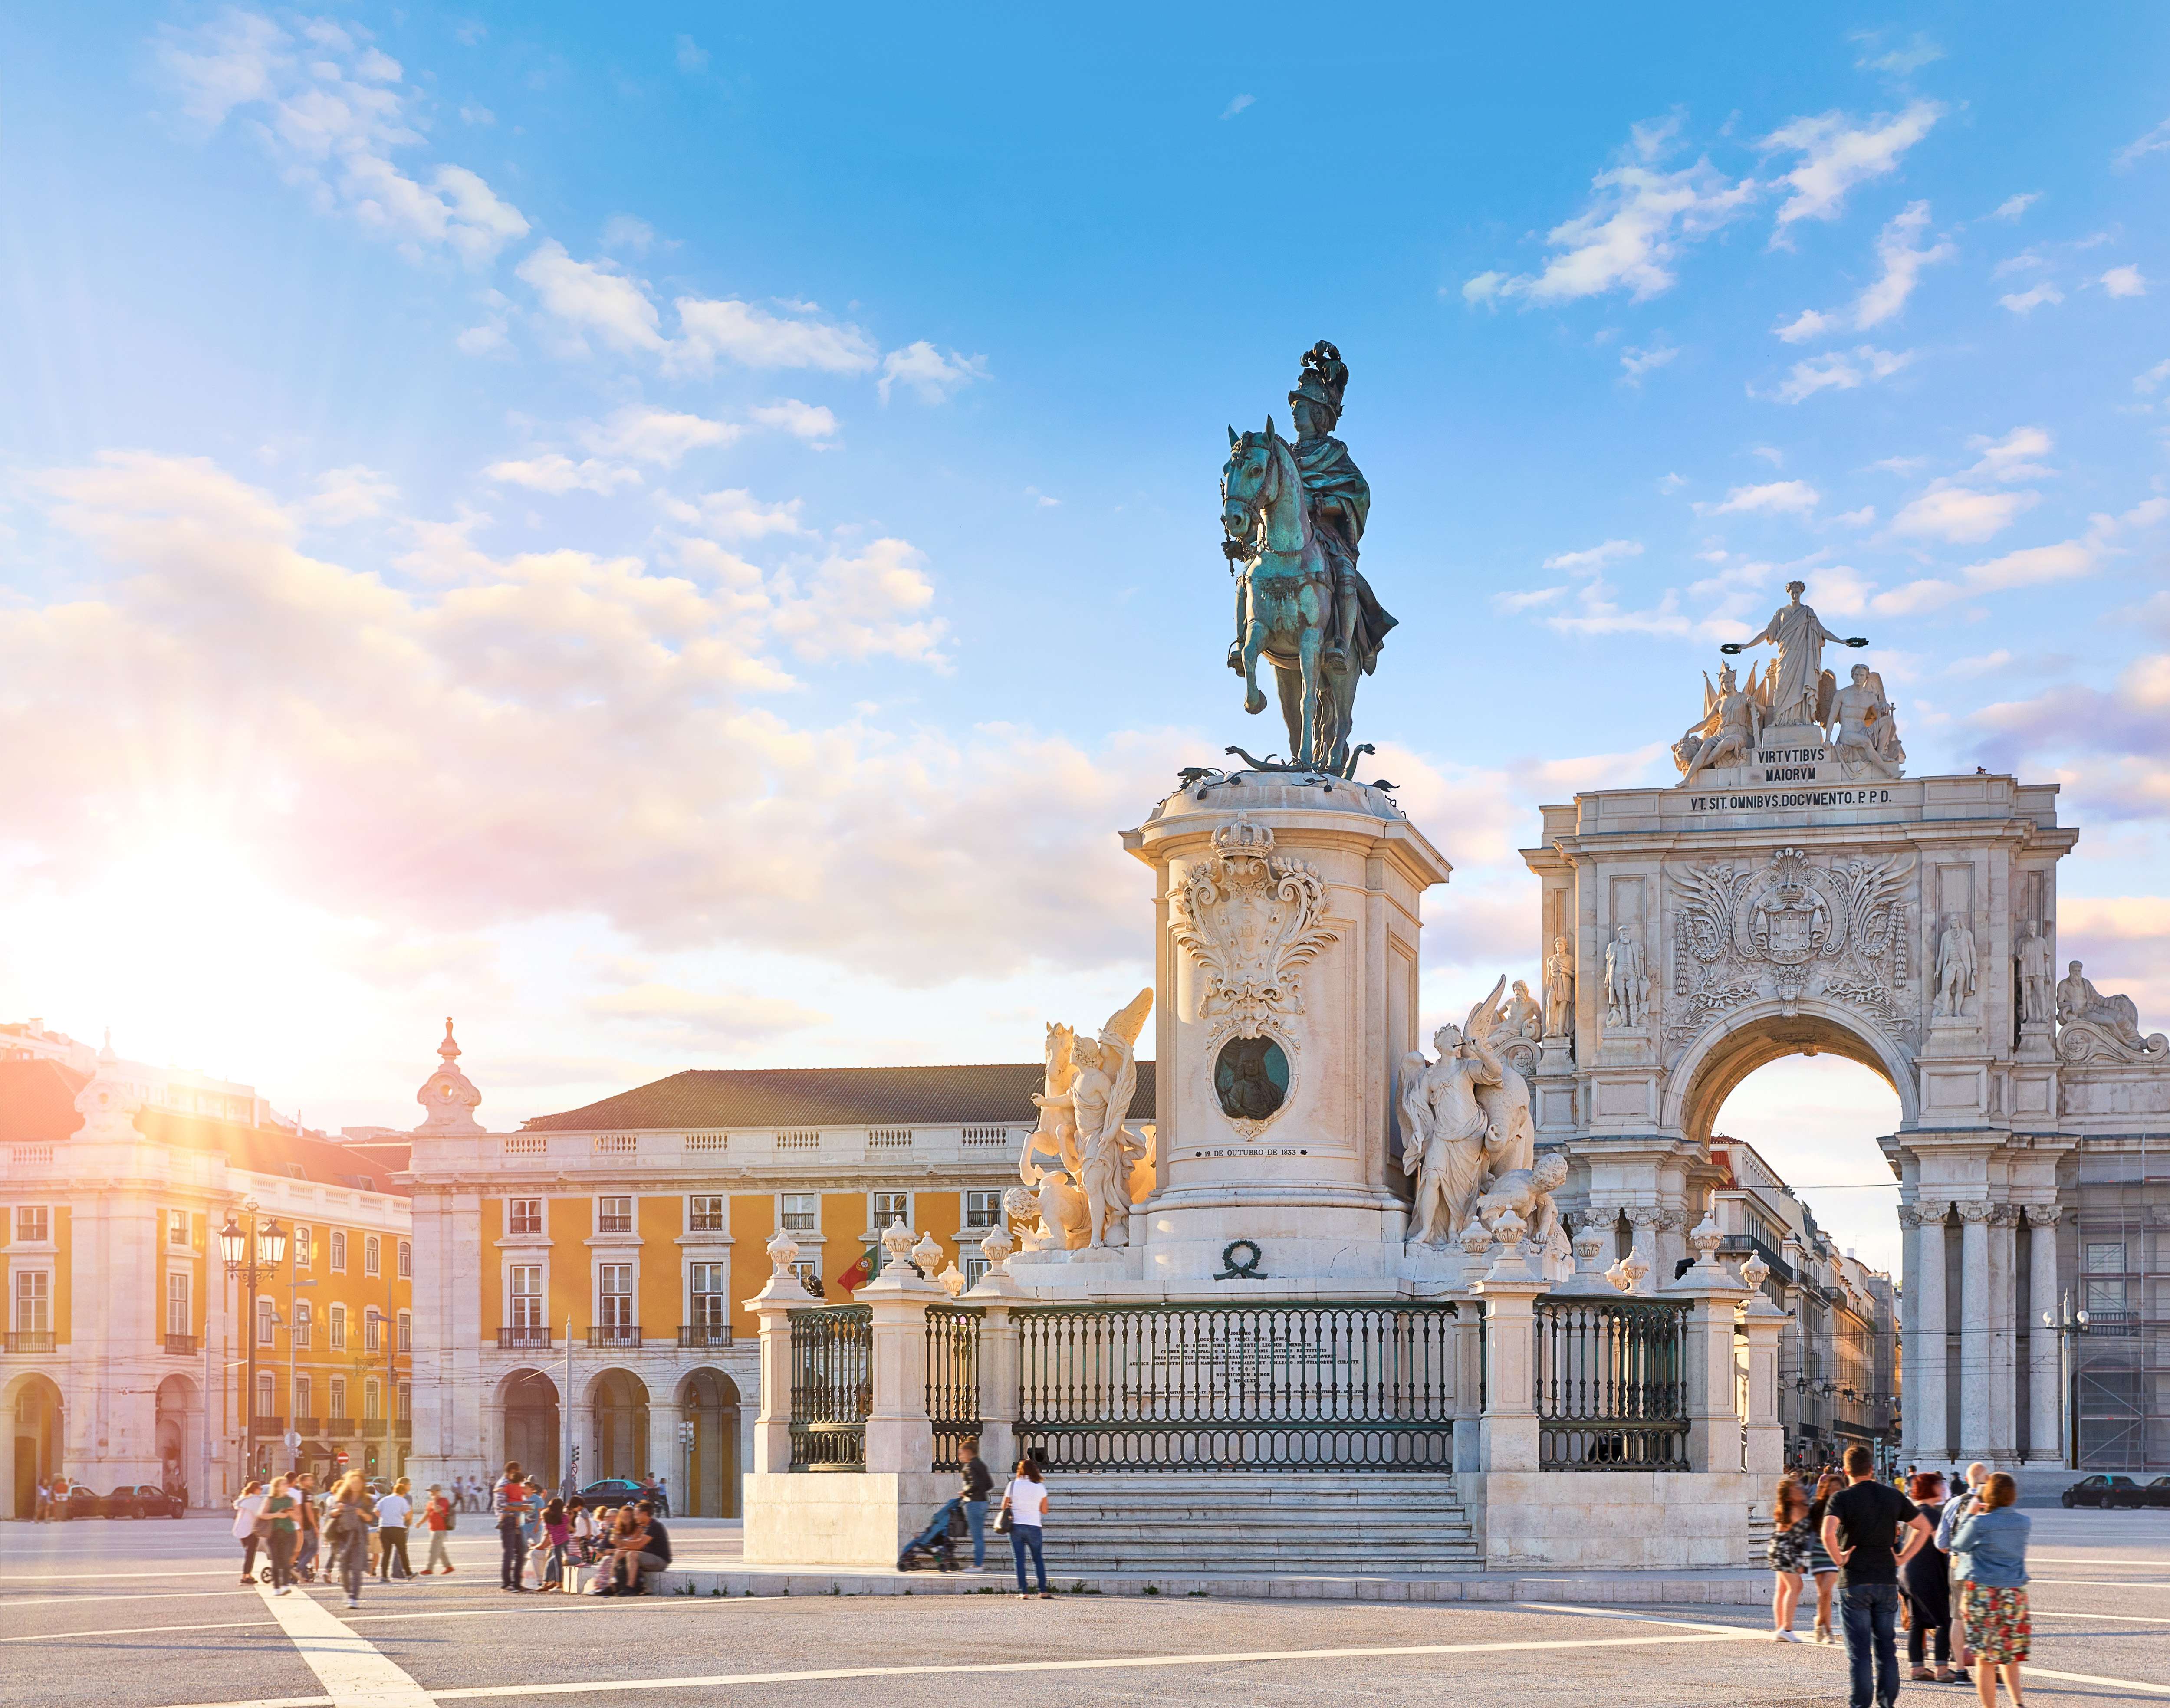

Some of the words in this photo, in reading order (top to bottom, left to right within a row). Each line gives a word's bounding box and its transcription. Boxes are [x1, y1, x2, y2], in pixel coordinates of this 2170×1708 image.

[1758, 749, 1825, 764] VIRTVTIBVS
[1766, 767, 1816, 782] MAIORVM
[1709, 797, 1727, 810] SIT.
